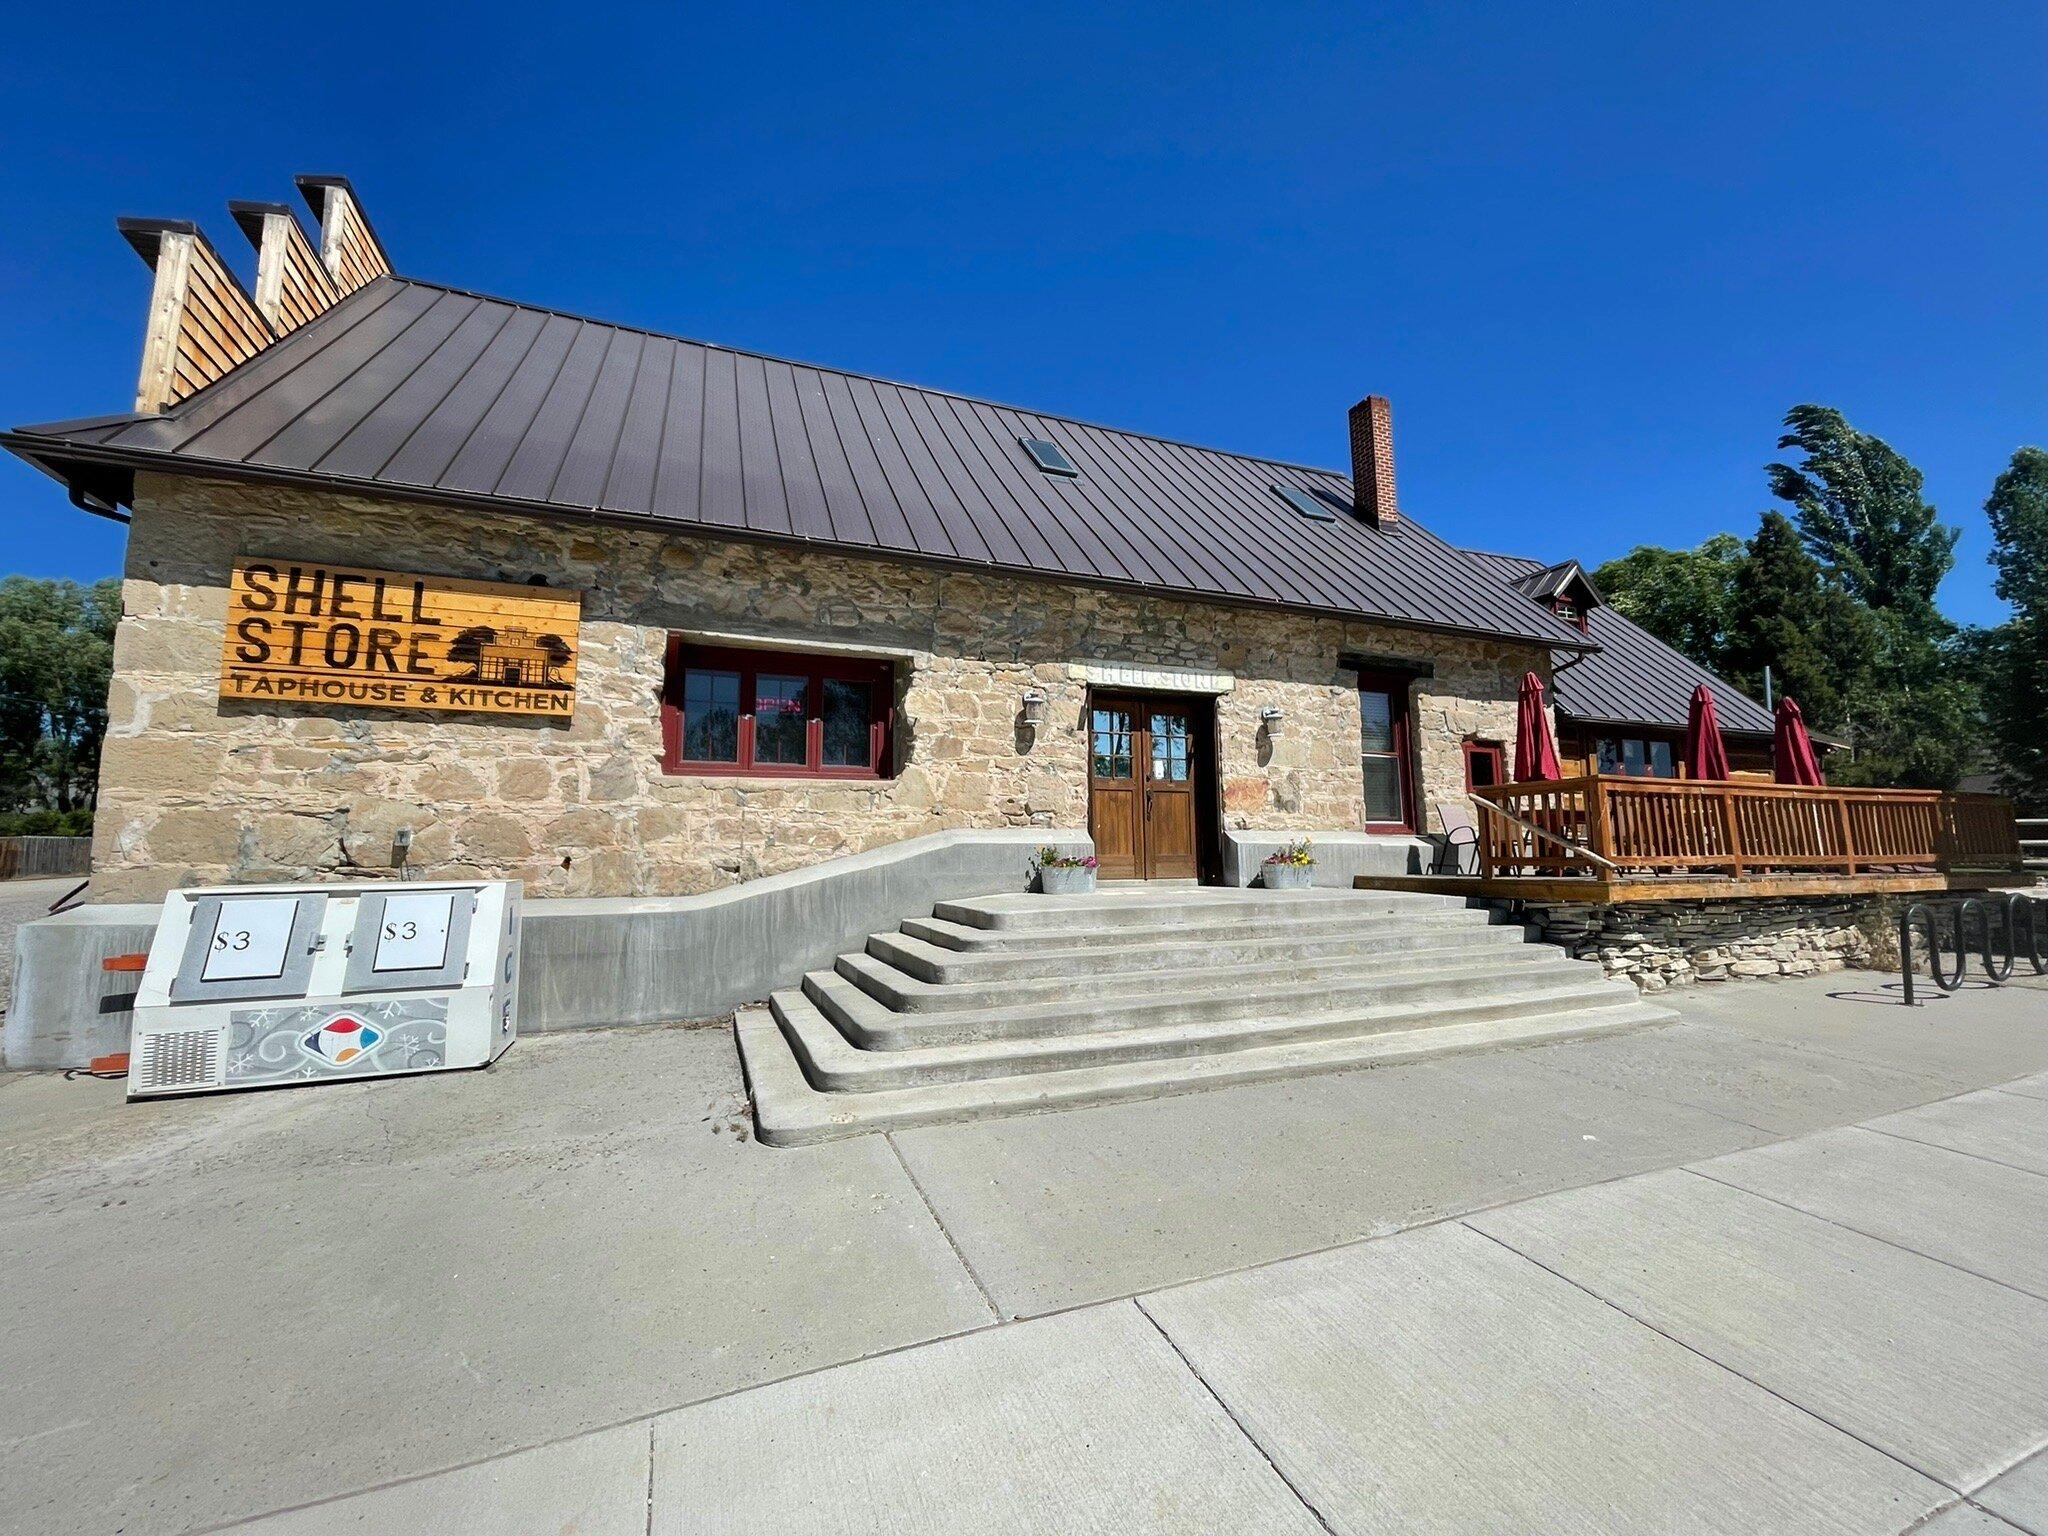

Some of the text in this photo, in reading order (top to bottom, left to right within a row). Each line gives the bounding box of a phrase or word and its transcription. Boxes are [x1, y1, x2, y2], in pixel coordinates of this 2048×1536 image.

[241, 564, 441, 625] SHELL
[235, 617, 440, 674] STORE
[232, 674, 569, 711] TAPHOUSE & KITCHEN
[1086, 663, 1219, 690] SHELL STORE
